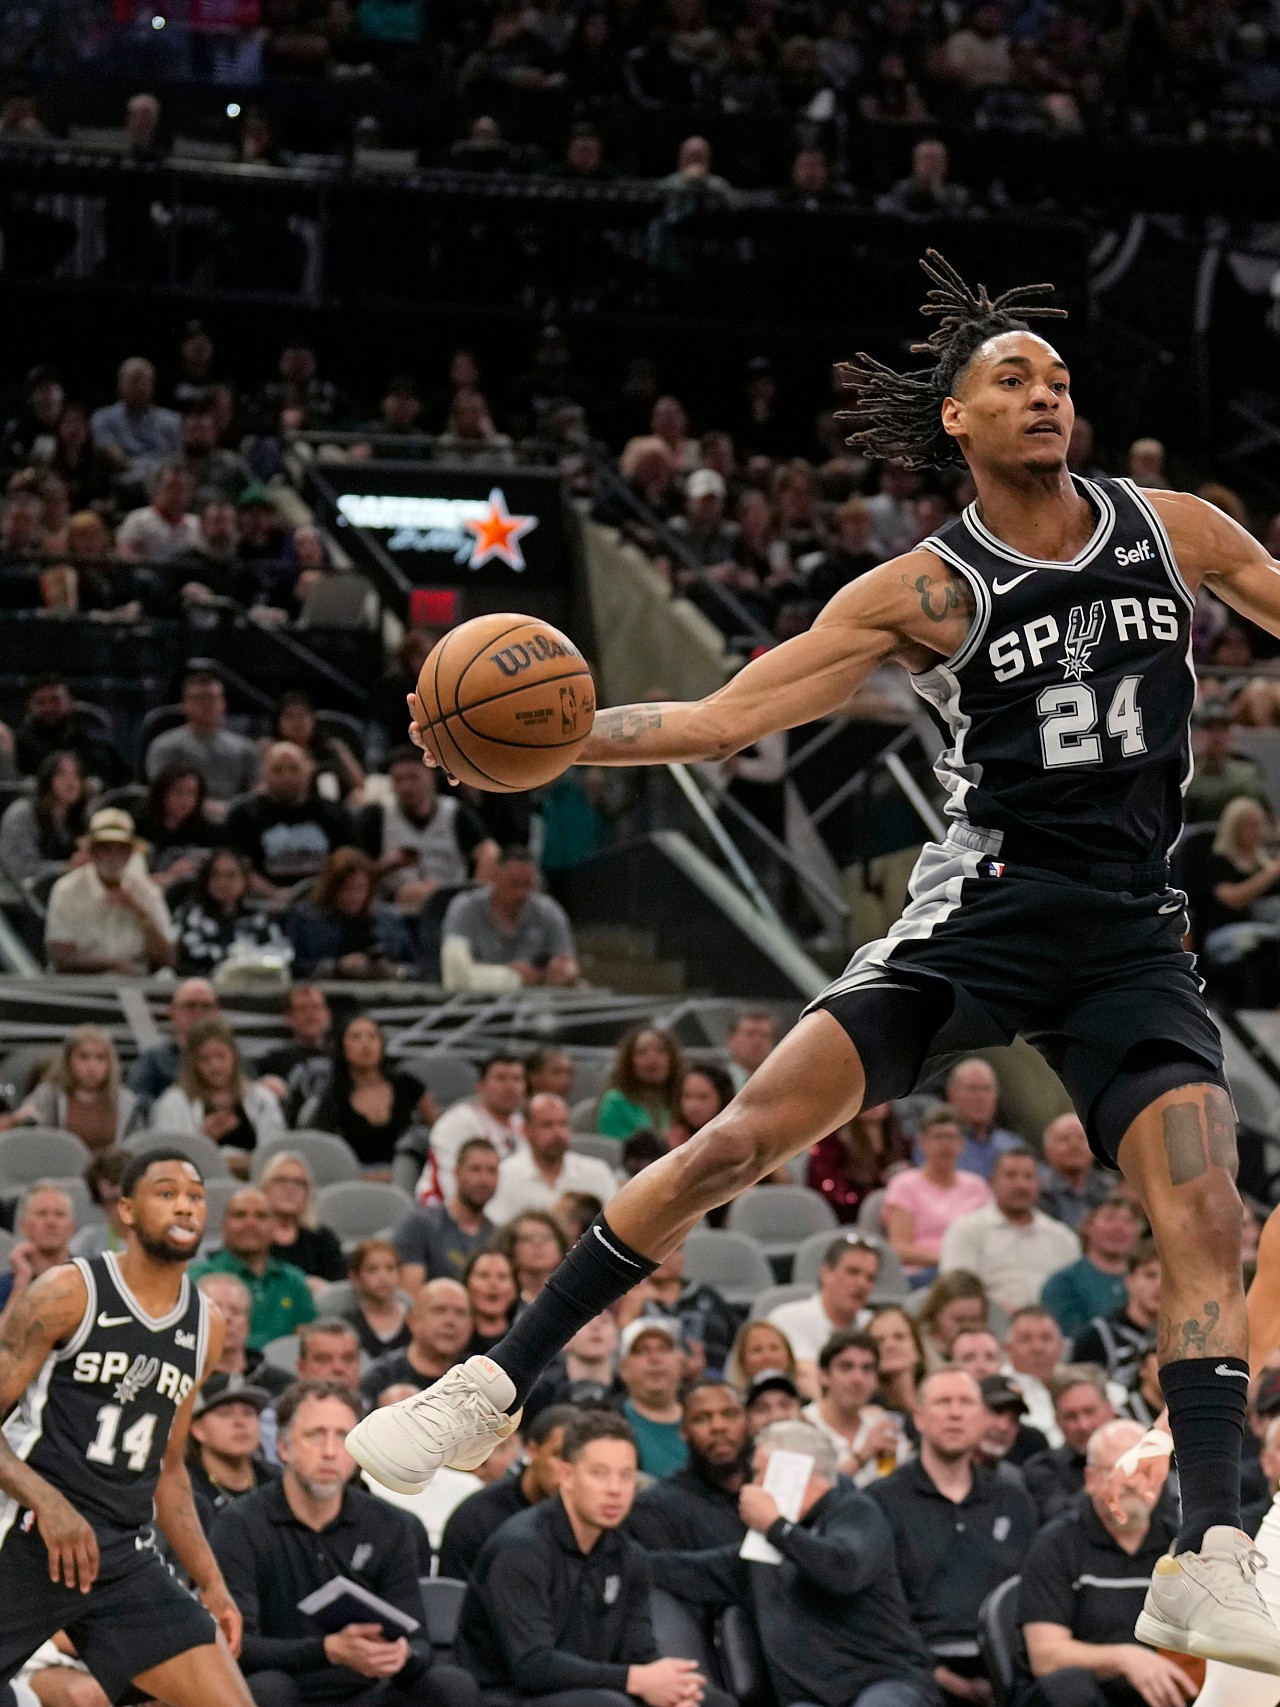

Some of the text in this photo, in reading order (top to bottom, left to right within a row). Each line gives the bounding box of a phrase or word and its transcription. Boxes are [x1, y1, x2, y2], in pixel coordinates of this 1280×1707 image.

[988, 597, 1179, 682] SPURS
[1035, 675, 1149, 769] 24
[86, 1402, 158, 1472] 14
